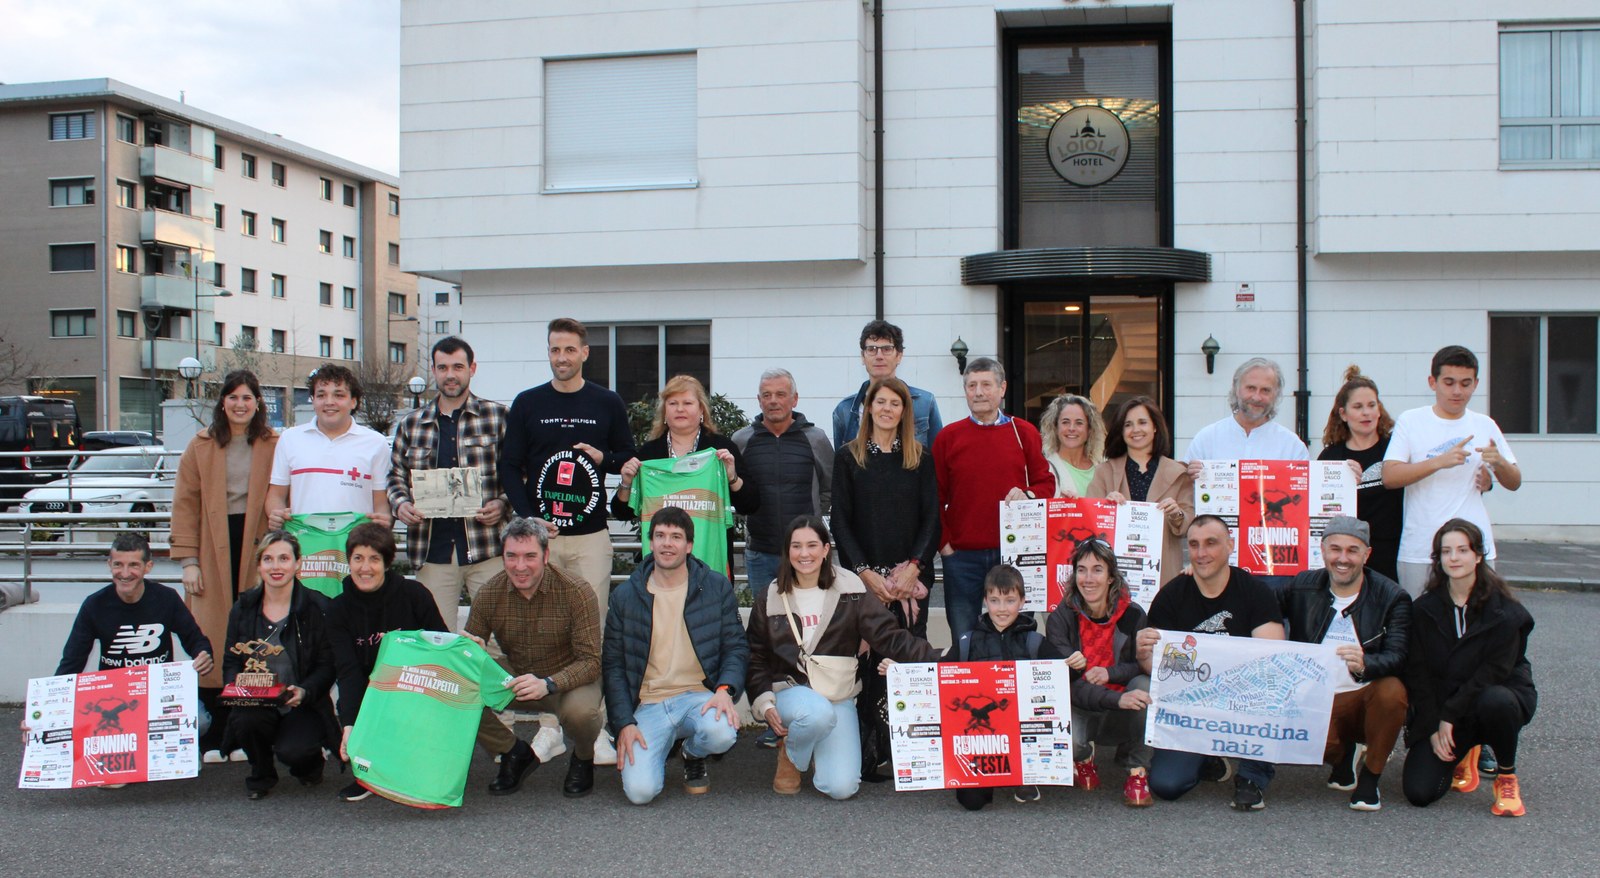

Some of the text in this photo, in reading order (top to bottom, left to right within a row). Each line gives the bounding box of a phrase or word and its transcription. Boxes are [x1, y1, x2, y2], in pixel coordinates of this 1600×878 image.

[1057, 139, 1120, 158] LOIOLA
[1073, 158, 1103, 166] HOTEL
[576, 455, 600, 488] MARATOI
[583, 491, 600, 514] ERDIA
[552, 517, 574, 527] 2024
[1248, 526, 1298, 545] RUNNING
[1272, 546, 1299, 564] ESTA
[399, 672, 460, 695] AZKOITIAZPEITIA
[1228, 700, 1248, 712] Iker
[1154, 707, 1309, 741] #mareaurdina
[83, 733, 137, 756] RUNNING
[953, 735, 1009, 755] RUNNING
[1212, 739, 1264, 757] naiz
[98, 753, 136, 772] FESTA
[973, 755, 1011, 774] FESTA
